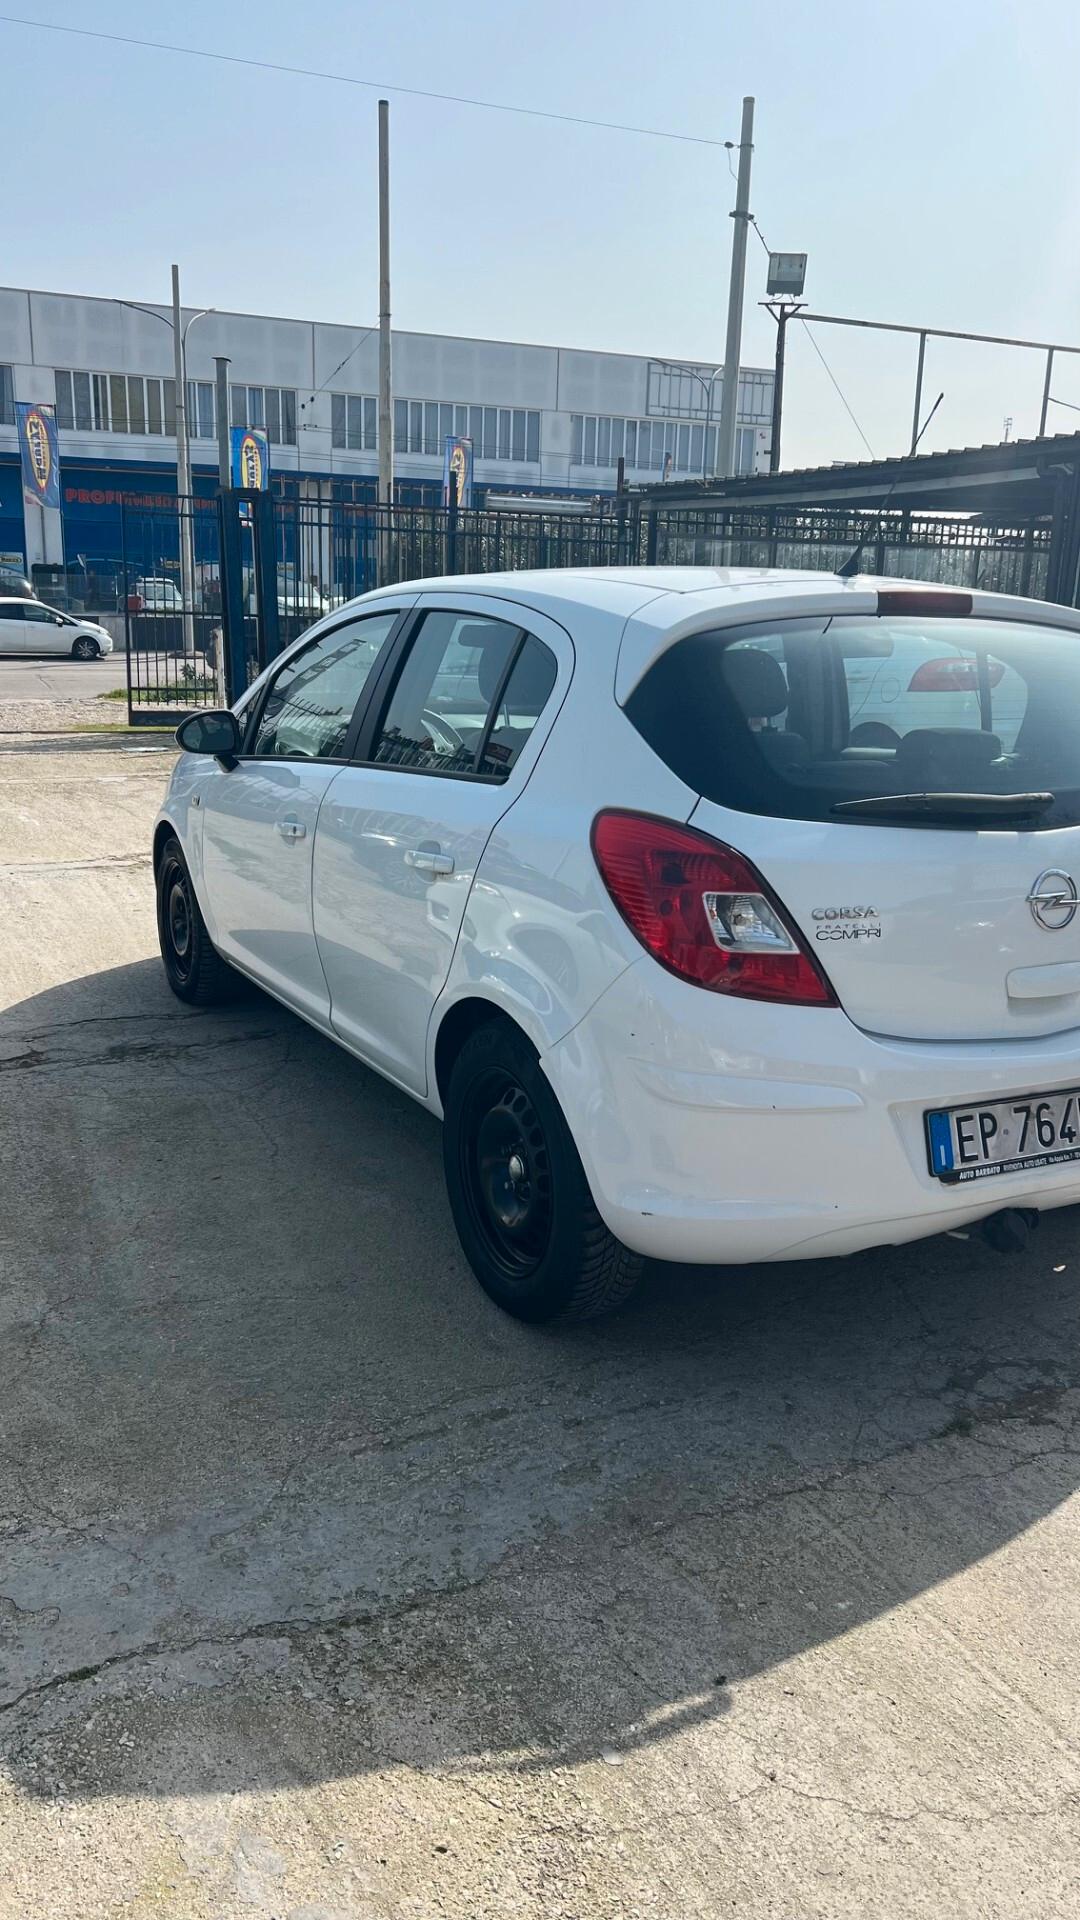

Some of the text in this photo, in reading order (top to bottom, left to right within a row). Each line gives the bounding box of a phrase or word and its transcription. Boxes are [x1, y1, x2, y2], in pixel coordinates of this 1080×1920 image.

[811, 905, 880, 921] CORSA
[816, 922, 881, 931] FRATELLI
[816, 928, 882, 941] COMPRI
[955, 1096, 1080, 1164] EP 764
[959, 1170, 975, 1180] AUTO
